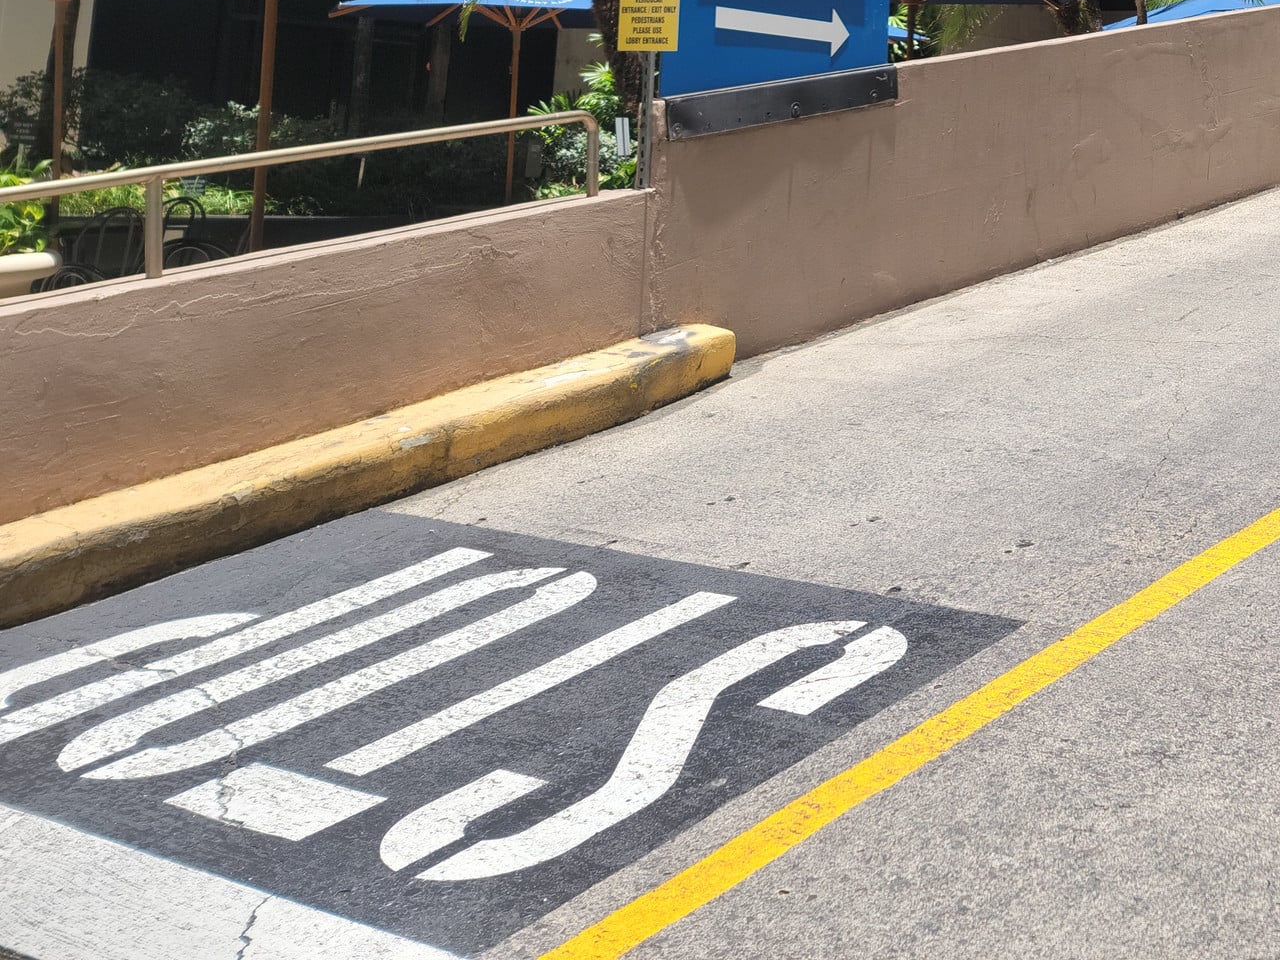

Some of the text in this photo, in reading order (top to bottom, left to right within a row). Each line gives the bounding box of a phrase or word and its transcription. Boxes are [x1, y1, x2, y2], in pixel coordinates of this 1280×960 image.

[622, 6, 647, 14] ENTRANCE
[651, 6, 662, 14] EXIT
[631, 16, 665, 24] PEDESTRIANS
[626, 37, 669, 45] LOBBY ENTRANCE
[0, 546, 908, 882] STOP
